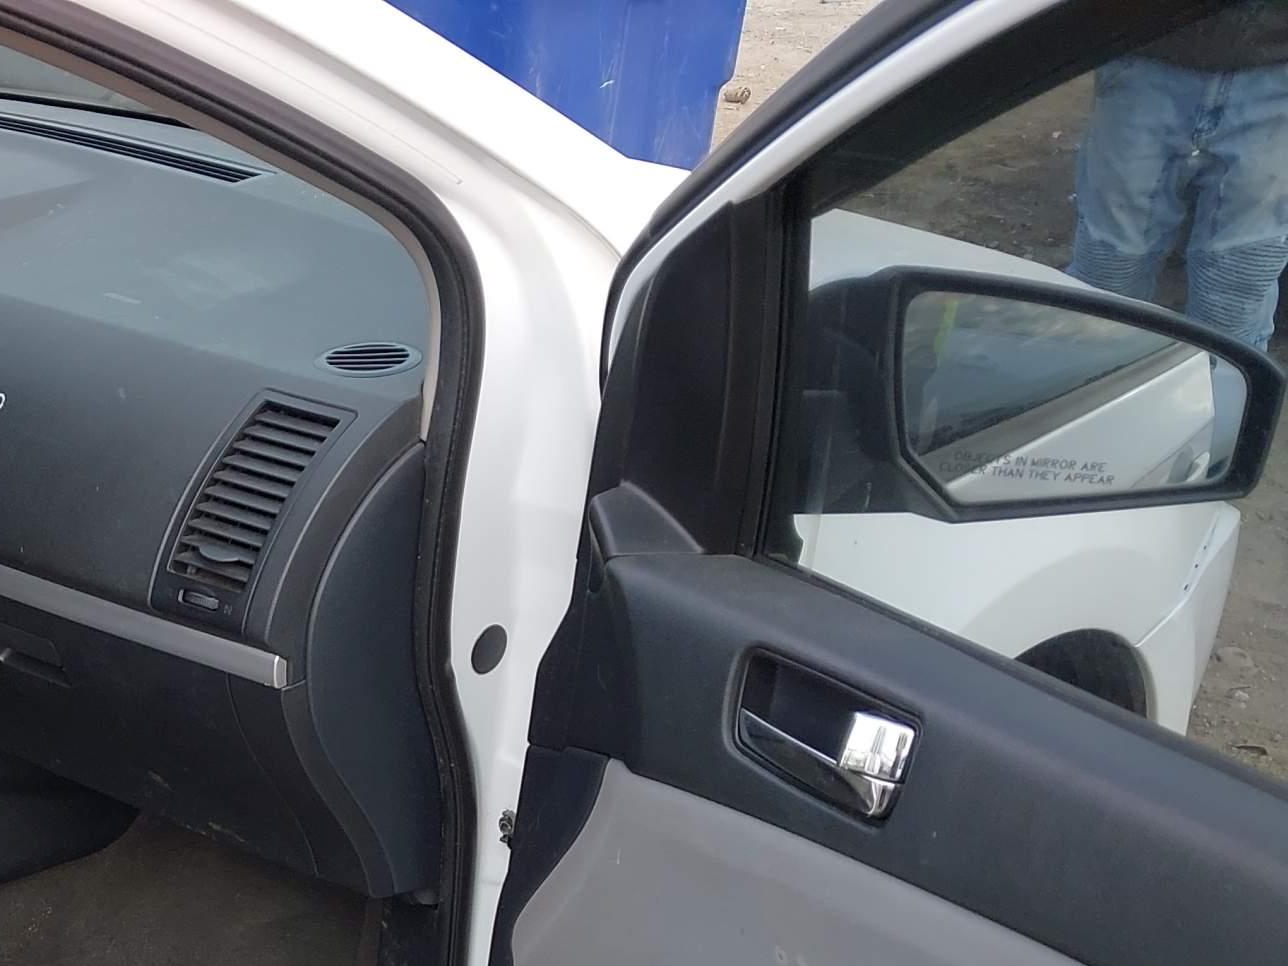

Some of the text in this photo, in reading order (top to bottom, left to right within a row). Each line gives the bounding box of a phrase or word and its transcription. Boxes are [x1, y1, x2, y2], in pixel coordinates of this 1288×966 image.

[1015, 456, 1027, 467] IN
[1031, 457, 1078, 470] MIRROR
[1081, 461, 1108, 473] ARE
[991, 465, 1024, 479] THAN
[1028, 469, 1060, 481] THEY
[1064, 473, 1115, 486] APPEAR
